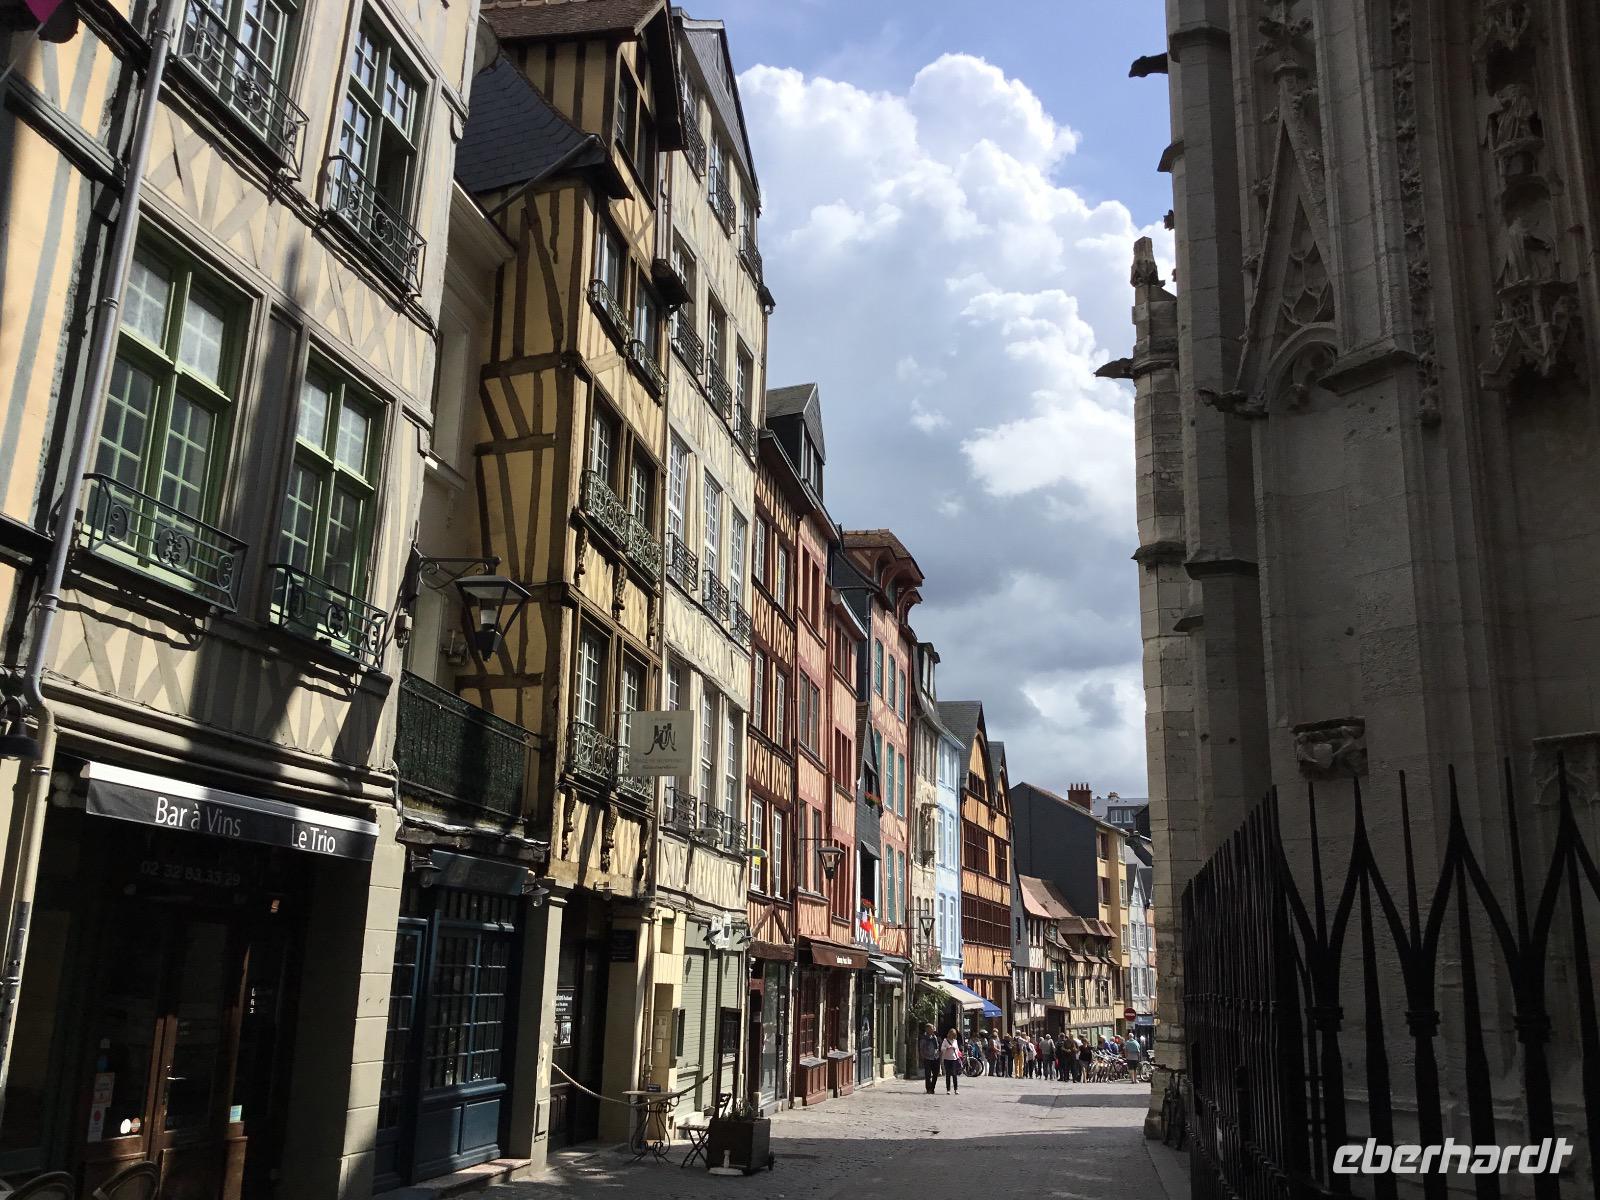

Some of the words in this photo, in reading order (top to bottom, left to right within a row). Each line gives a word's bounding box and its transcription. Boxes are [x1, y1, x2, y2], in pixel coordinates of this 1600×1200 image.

[155, 796, 187, 828] Bar
[190, 803, 201, 831] à
[206, 807, 242, 838] Vins
[291, 823, 307, 848] Le
[310, 827, 336, 853] Trio
